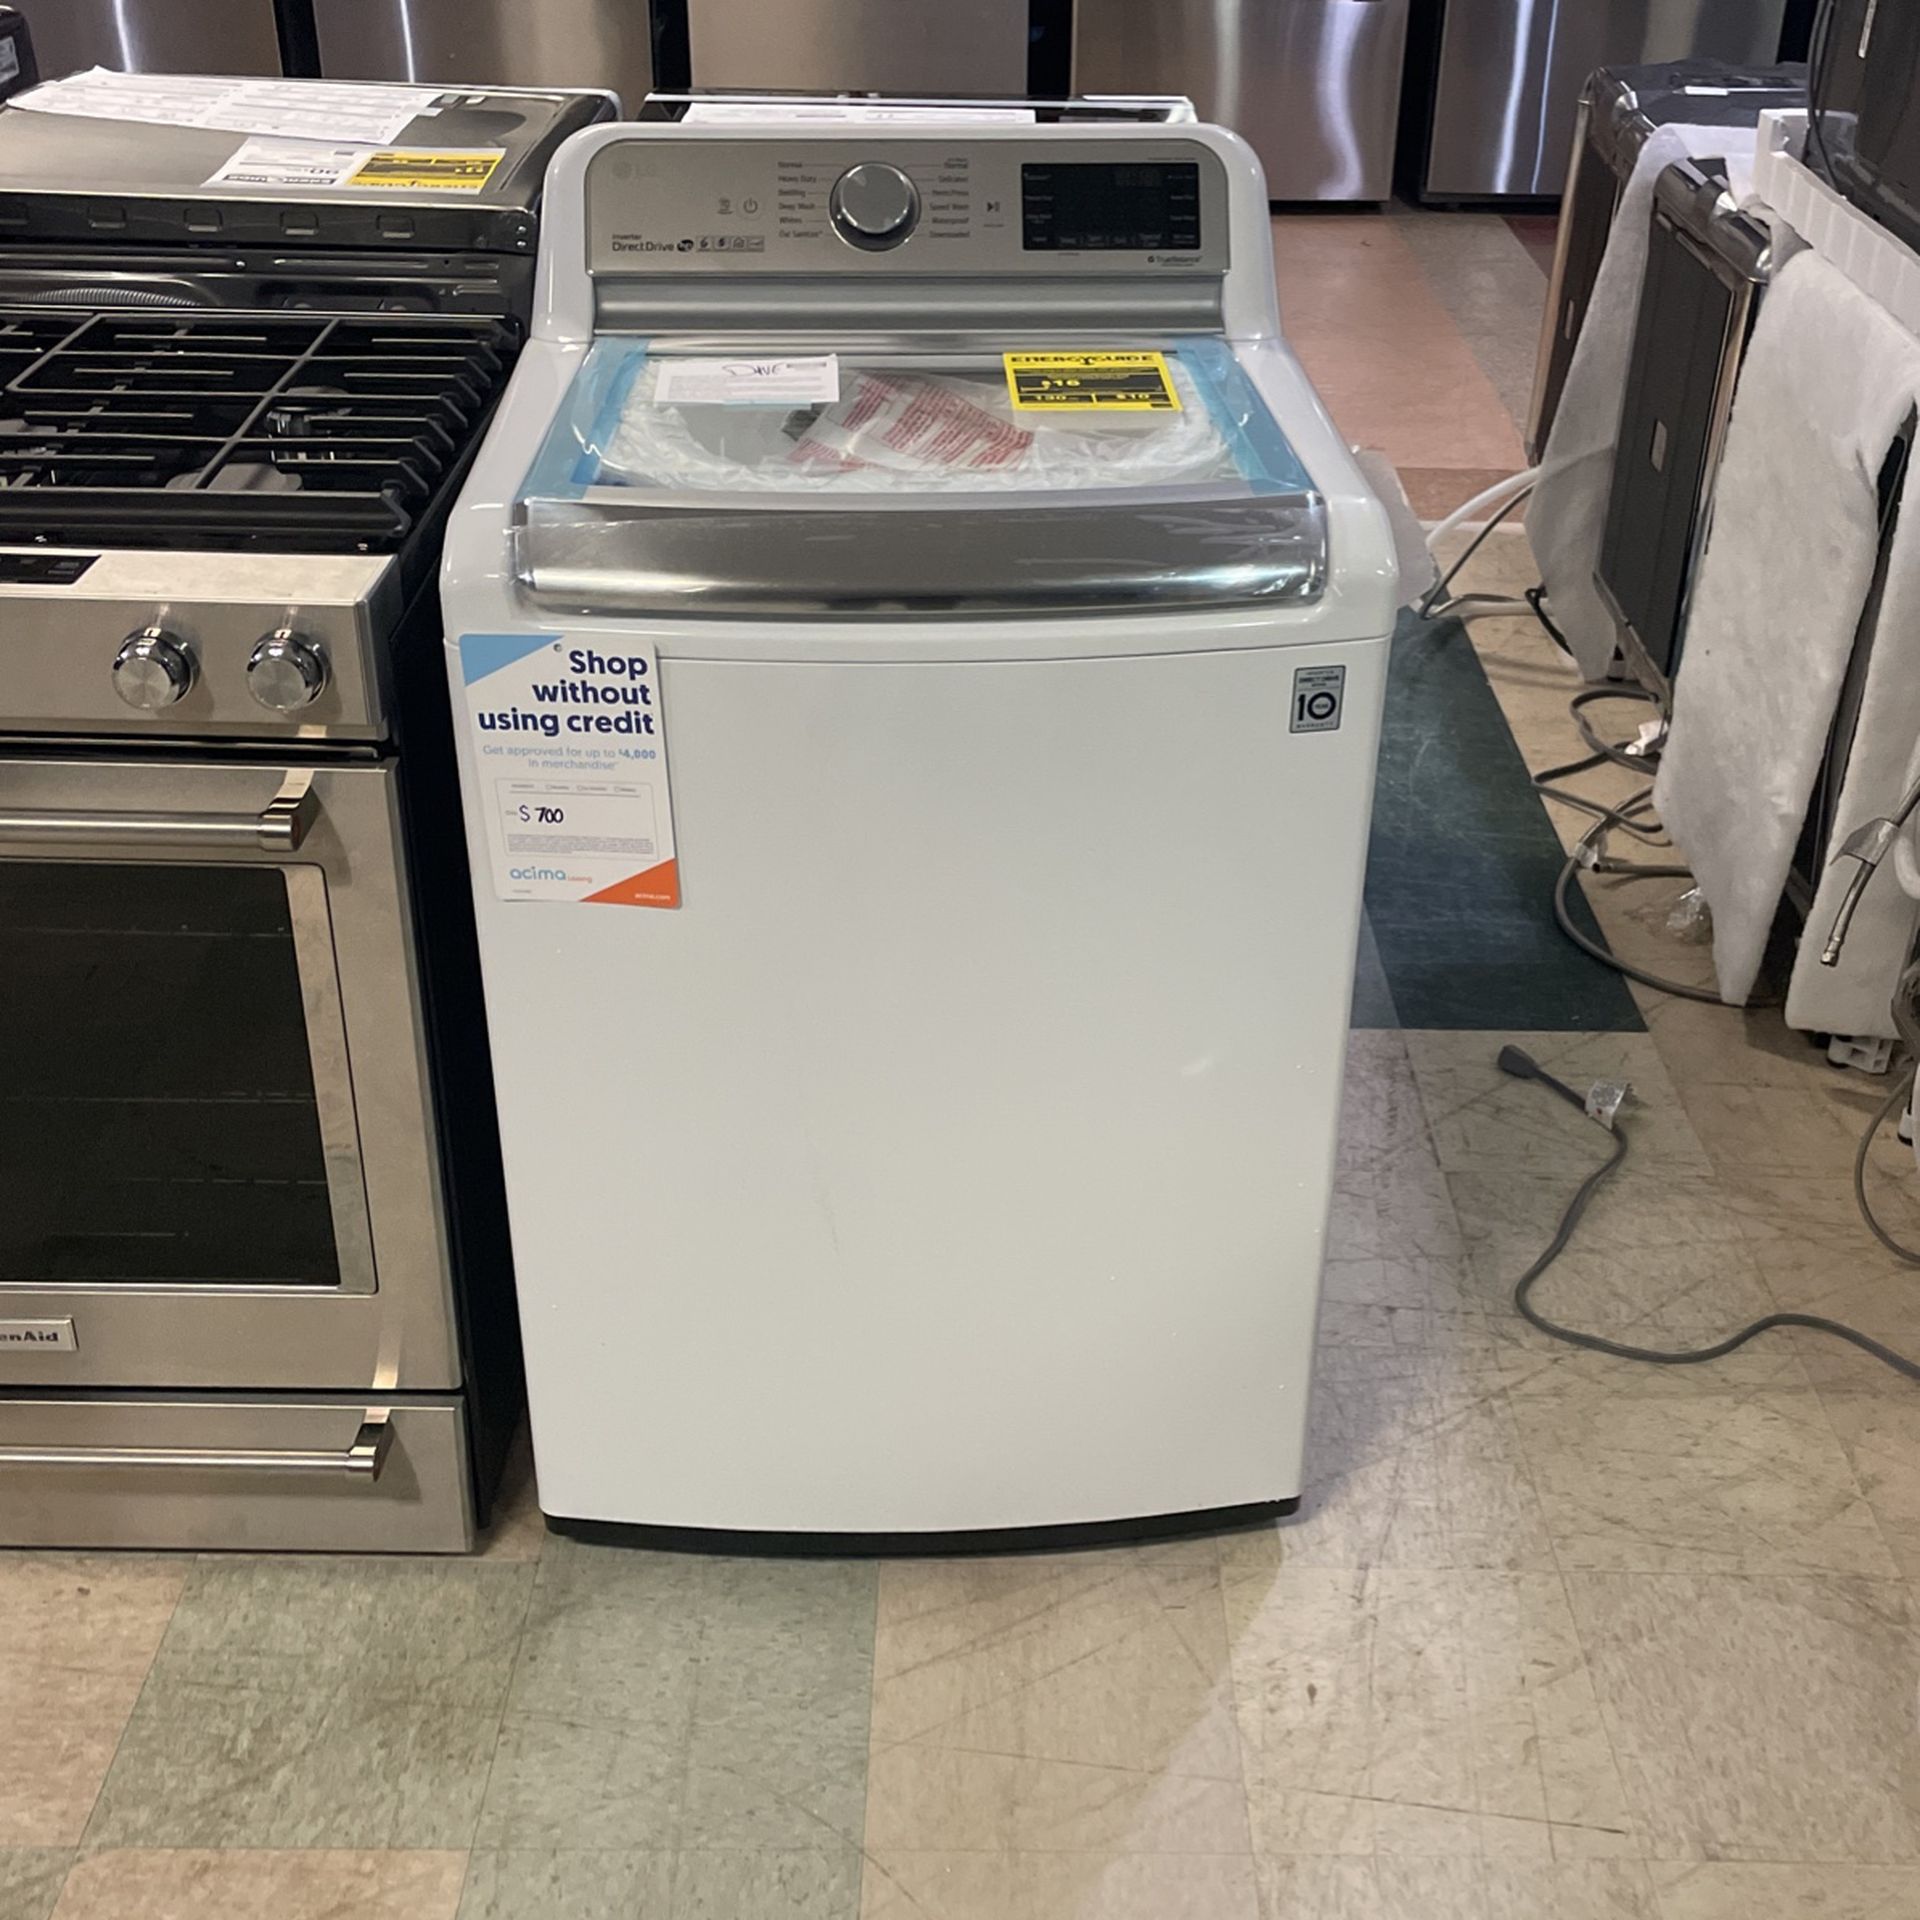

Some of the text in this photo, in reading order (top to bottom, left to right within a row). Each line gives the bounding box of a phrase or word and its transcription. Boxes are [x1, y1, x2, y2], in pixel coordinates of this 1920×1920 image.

[569, 649, 648, 681] Shop
[531, 679, 652, 706] without
[1298, 691, 1337, 721] 10
[478, 707, 655, 737] using credit
[482, 744, 657, 761] Get approved for up to $4,000
[527, 758, 540, 768] in
[534, 806, 565, 824] 700
[509, 866, 567, 881] acima
